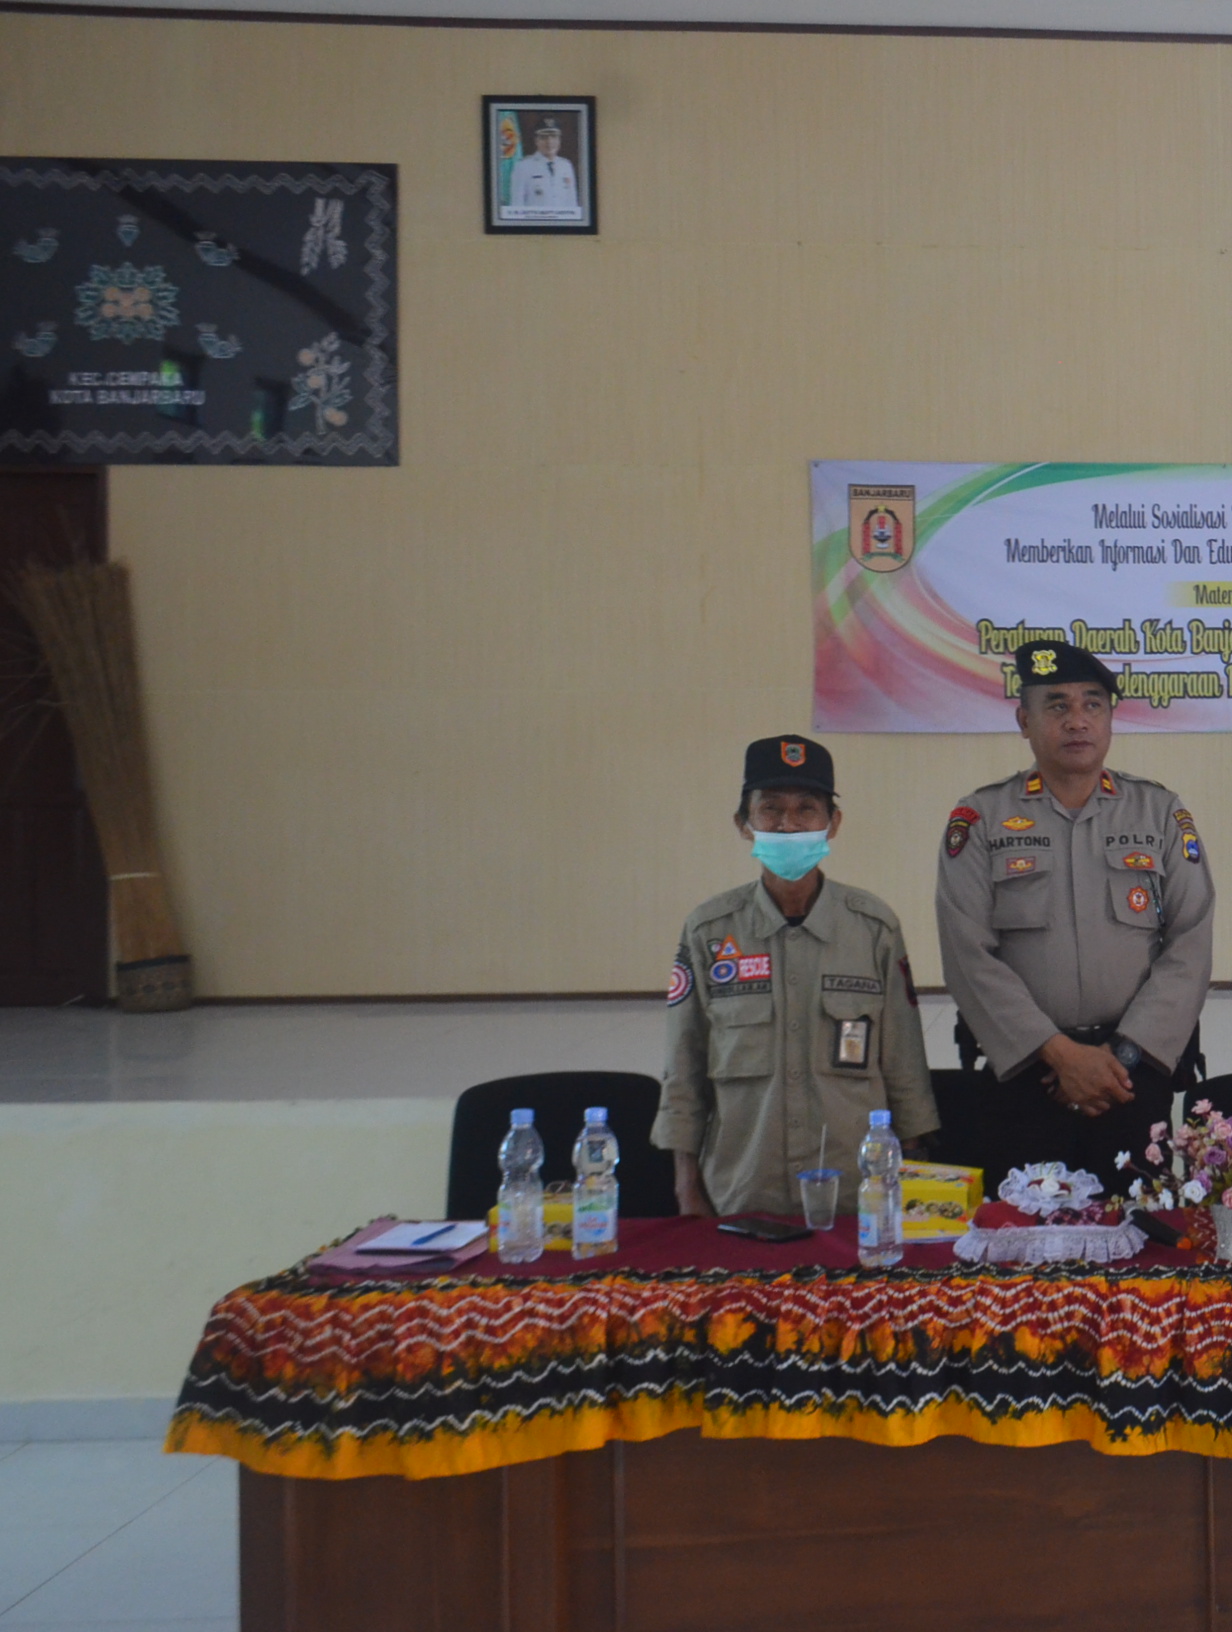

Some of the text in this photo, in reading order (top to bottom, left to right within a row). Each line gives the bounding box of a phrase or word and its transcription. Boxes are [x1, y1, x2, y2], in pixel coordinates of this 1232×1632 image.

[1092, 503, 1147, 529] Melalui
[1151, 503, 1228, 530] Sosialisasi
[1004, 537, 1095, 564] Memberikan
[1099, 538, 1168, 572] Informasi
[1171, 538, 1203, 564] Dan
[1070, 618, 1140, 654] Daerah
[1141, 618, 1187, 654] Kota
[1111, 663, 1223, 708] elenggaraan
[989, 836, 1051, 852] HARTONO
[1105, 834, 1163, 850] POLRI
